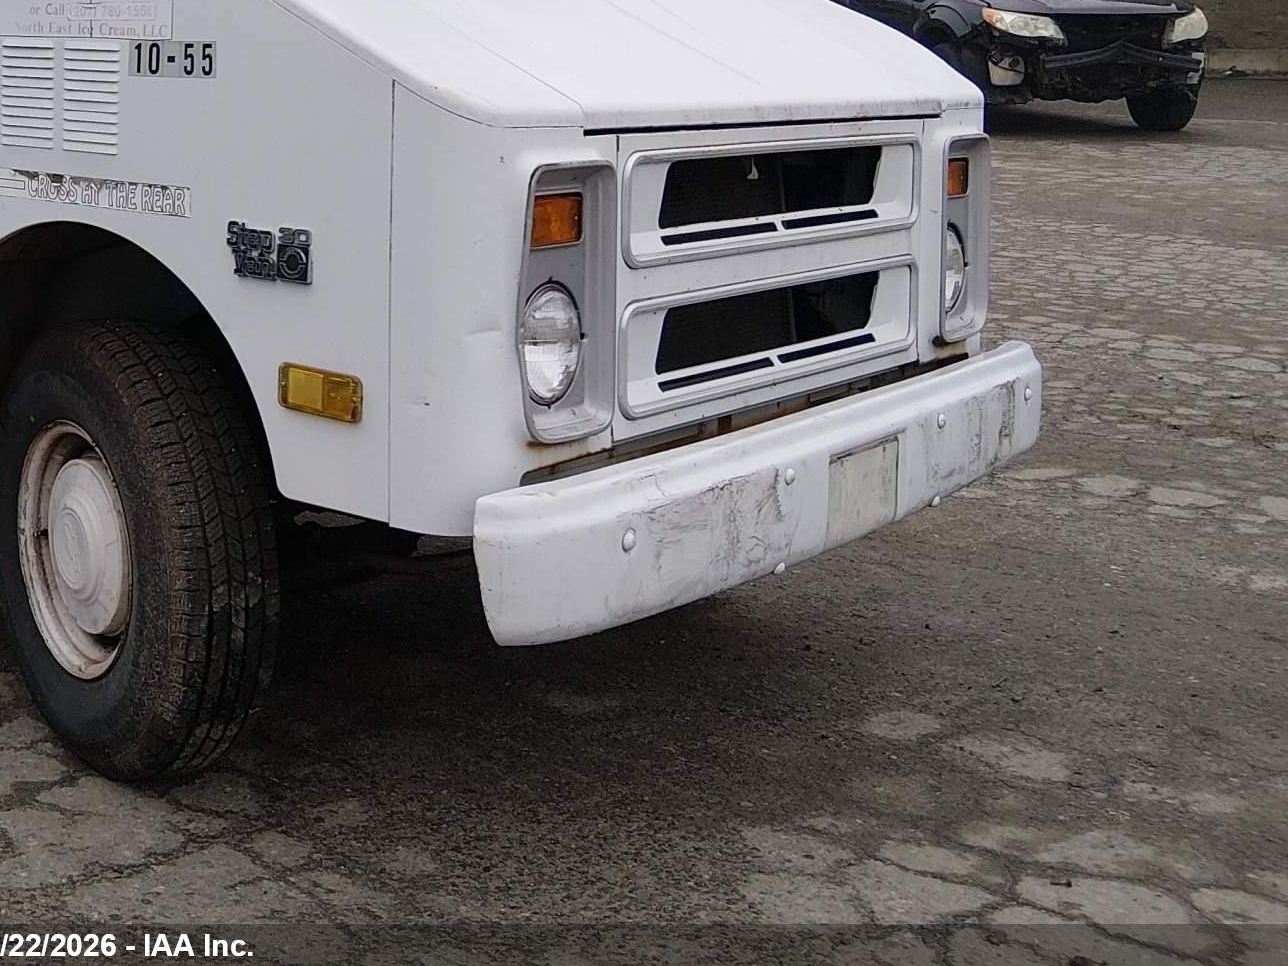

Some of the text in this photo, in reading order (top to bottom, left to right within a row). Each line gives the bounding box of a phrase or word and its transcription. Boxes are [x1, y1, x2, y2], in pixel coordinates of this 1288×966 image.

[29, 5, 40, 15] or
[45, 3, 65, 16] Call
[15, 21, 44, 35] North
[49, 22, 72, 35] East
[78, 22, 94, 35] Ice
[143, 24, 168, 38] LLC
[134, 42, 213, 76] 10-55
[105, 180, 137, 210] THE
[141, 185, 186, 215] REAR
[227, 220, 312, 254] Step 30
[233, 249, 277, 281] Van
